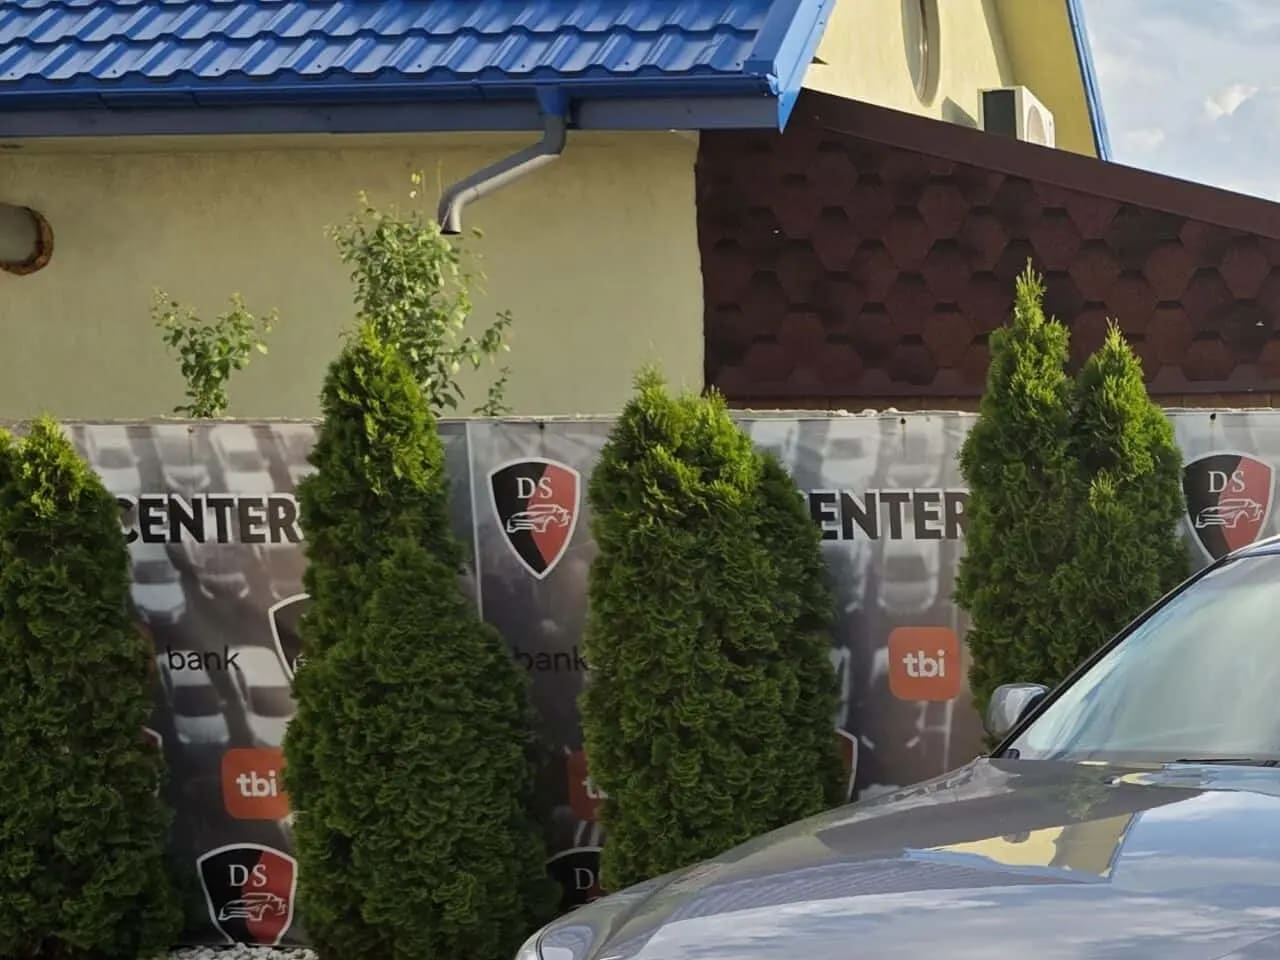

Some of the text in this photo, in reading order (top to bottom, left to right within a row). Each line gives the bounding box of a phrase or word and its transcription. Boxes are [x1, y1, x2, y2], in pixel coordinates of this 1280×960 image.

[516, 477, 554, 500] DS
[1208, 471, 1246, 494] DS
[799, 491, 970, 541] ENTER
[167, 645, 241, 671] bank
[902, 649, 946, 678] tbi
[235, 770, 278, 797] tbi
[228, 863, 268, 888] DS
